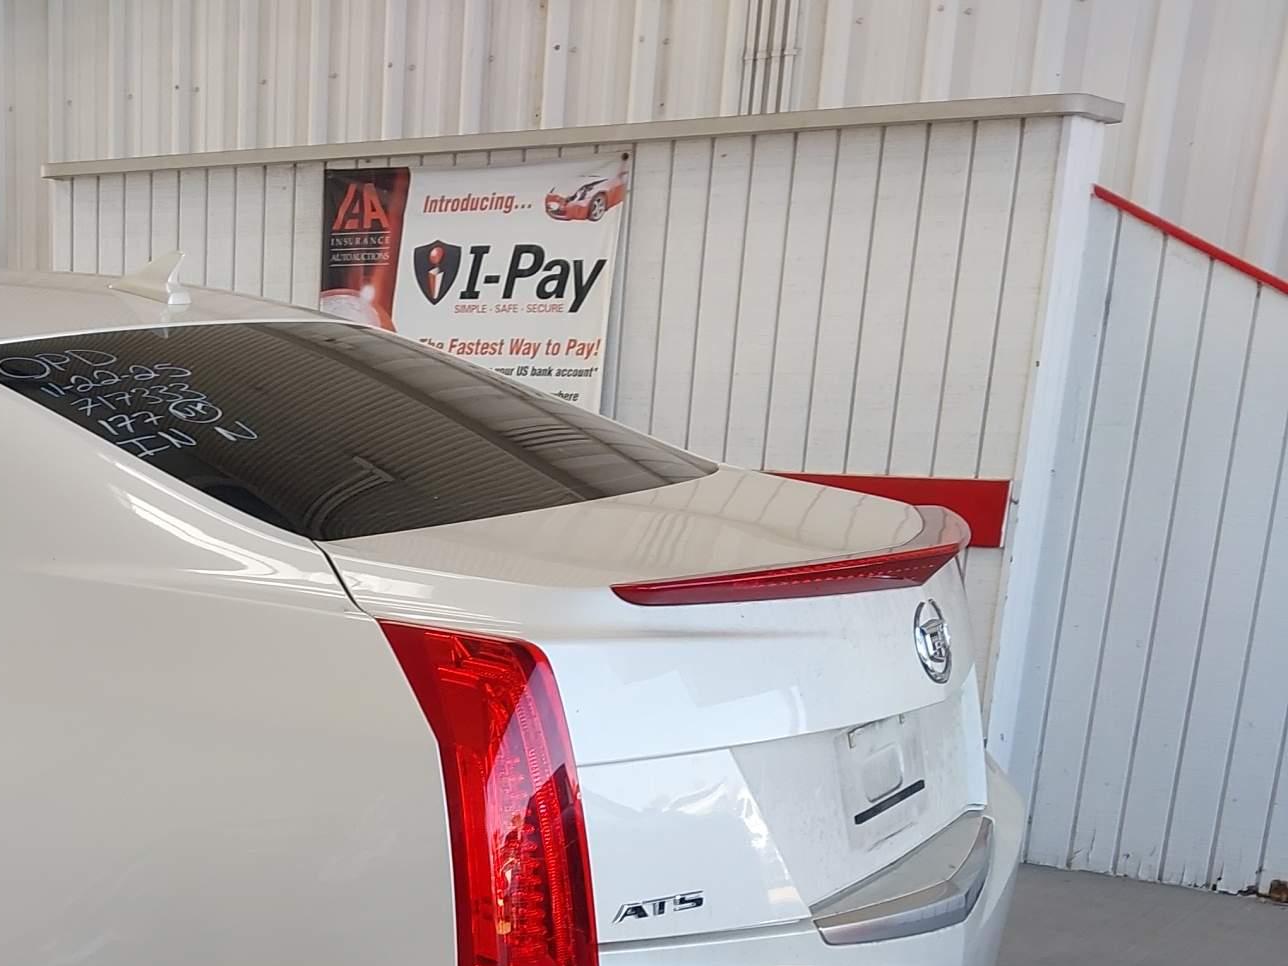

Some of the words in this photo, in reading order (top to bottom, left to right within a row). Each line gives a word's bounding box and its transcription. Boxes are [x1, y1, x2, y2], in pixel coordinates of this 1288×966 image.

[423, 192, 532, 213] Introducing...
[459, 244, 607, 313] I-Pay
[454, 304, 487, 313] SIMPLE
[495, 304, 519, 313] SAFE
[526, 303, 565, 313] SECURE
[448, 338, 503, 356] Fastest
[509, 338, 541, 359] Way
[545, 341, 561, 356] to
[565, 338, 602, 360] Pay!
[40, 363, 192, 398] 11-22-25
[516, 366, 529, 376] US
[530, 366, 553, 376] bank
[70, 383, 207, 417] 717333
[98, 411, 165, 436] 177
[612, 890, 704, 924] ATS
